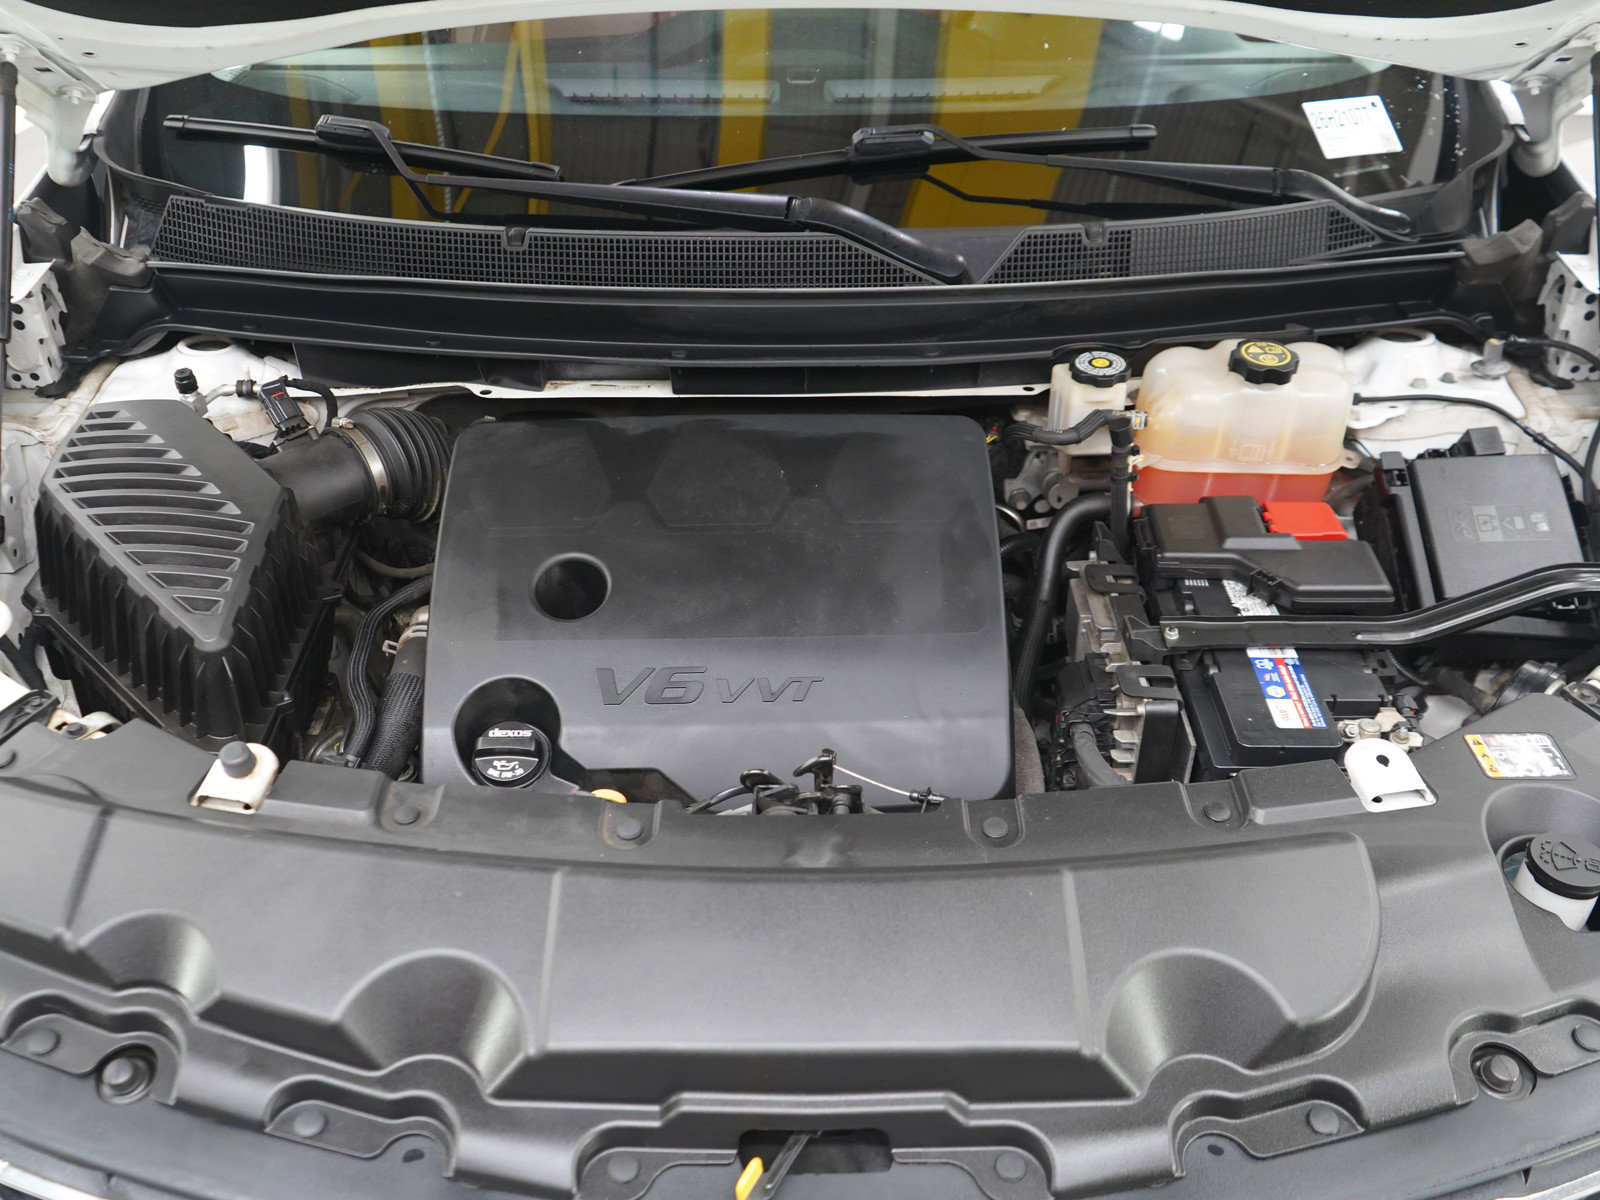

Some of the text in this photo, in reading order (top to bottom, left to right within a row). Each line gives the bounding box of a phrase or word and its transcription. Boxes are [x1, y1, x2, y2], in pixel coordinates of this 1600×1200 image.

[596, 666, 824, 706] V6 VVT
[488, 728, 534, 738] dexos
